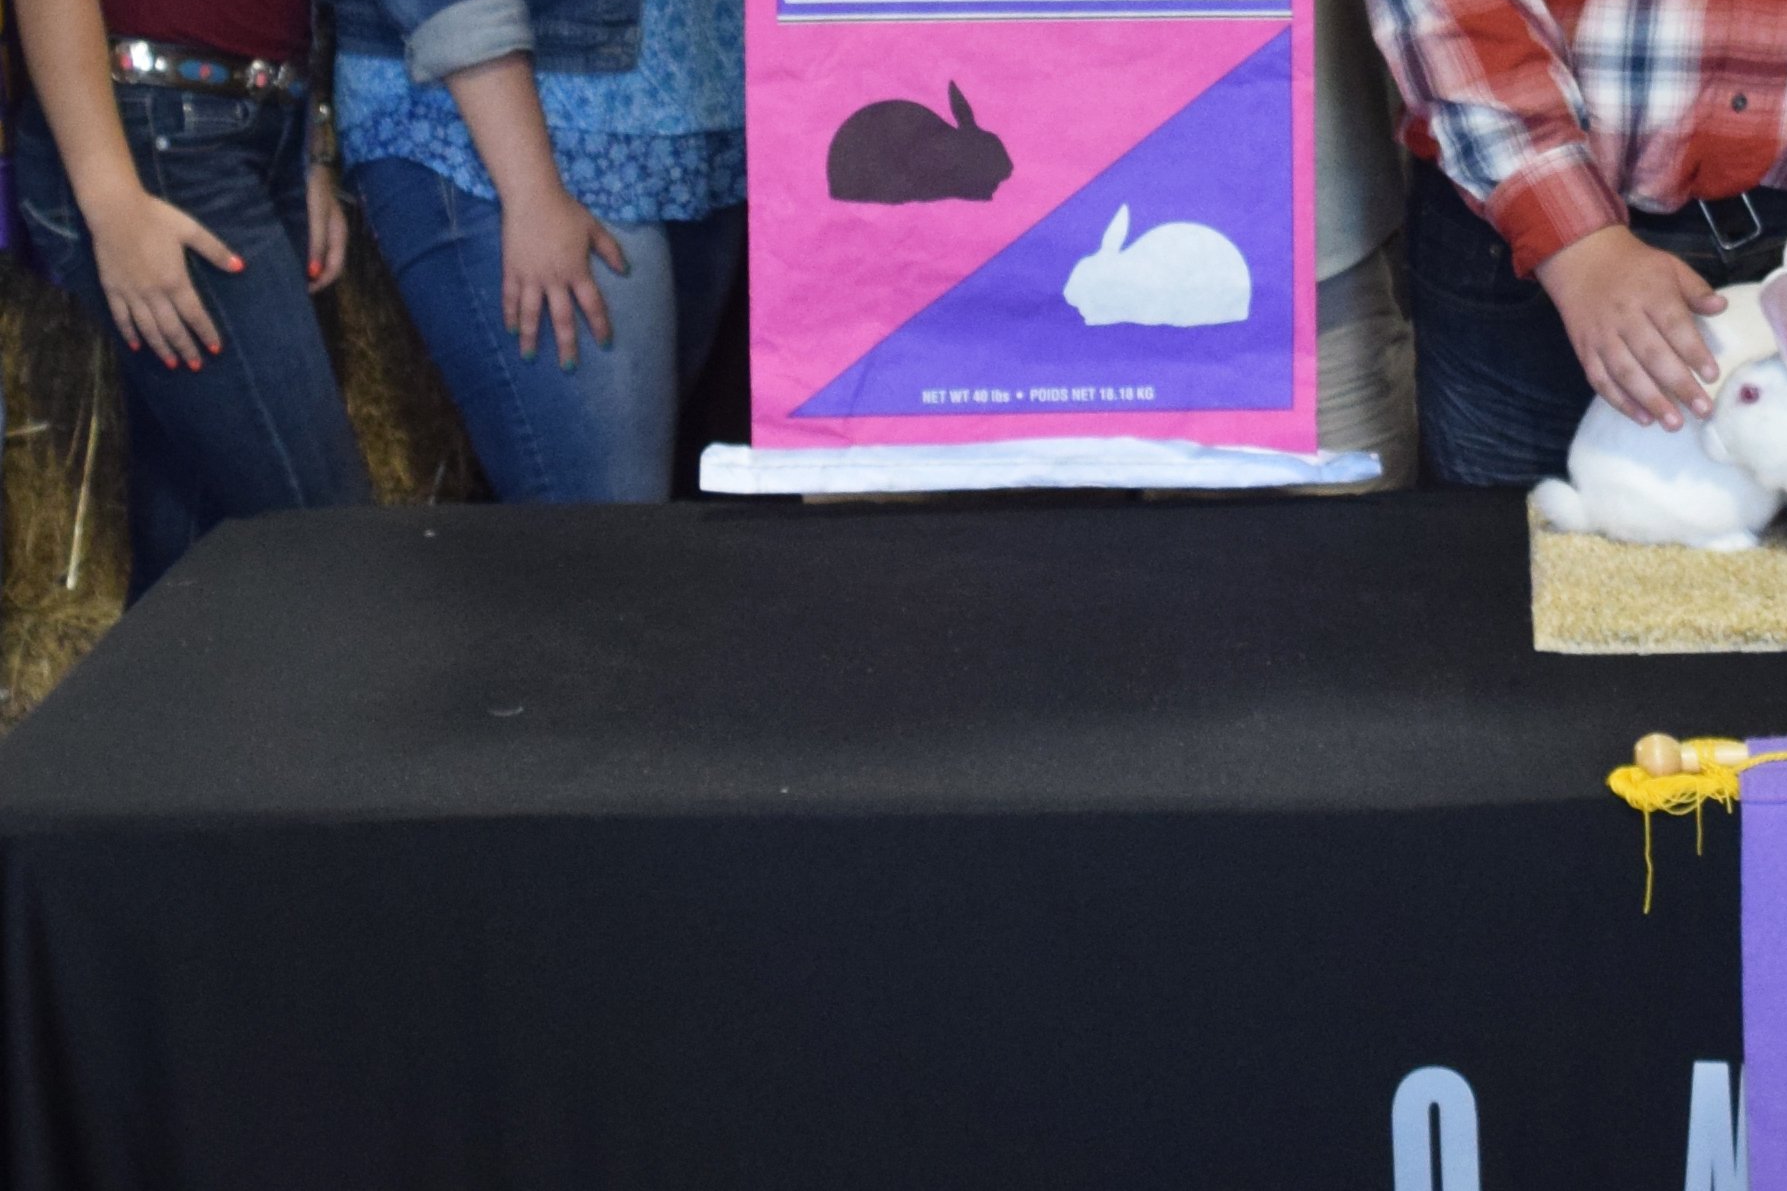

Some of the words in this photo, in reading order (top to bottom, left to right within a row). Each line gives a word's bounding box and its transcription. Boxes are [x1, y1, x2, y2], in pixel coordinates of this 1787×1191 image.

[922, 389, 946, 404] NET
[949, 389, 969, 404] WT
[972, 389, 987, 403] 40
[1029, 388, 1069, 402] POIDS
[1072, 387, 1095, 401] NET
[1137, 386, 1155, 400] KG
